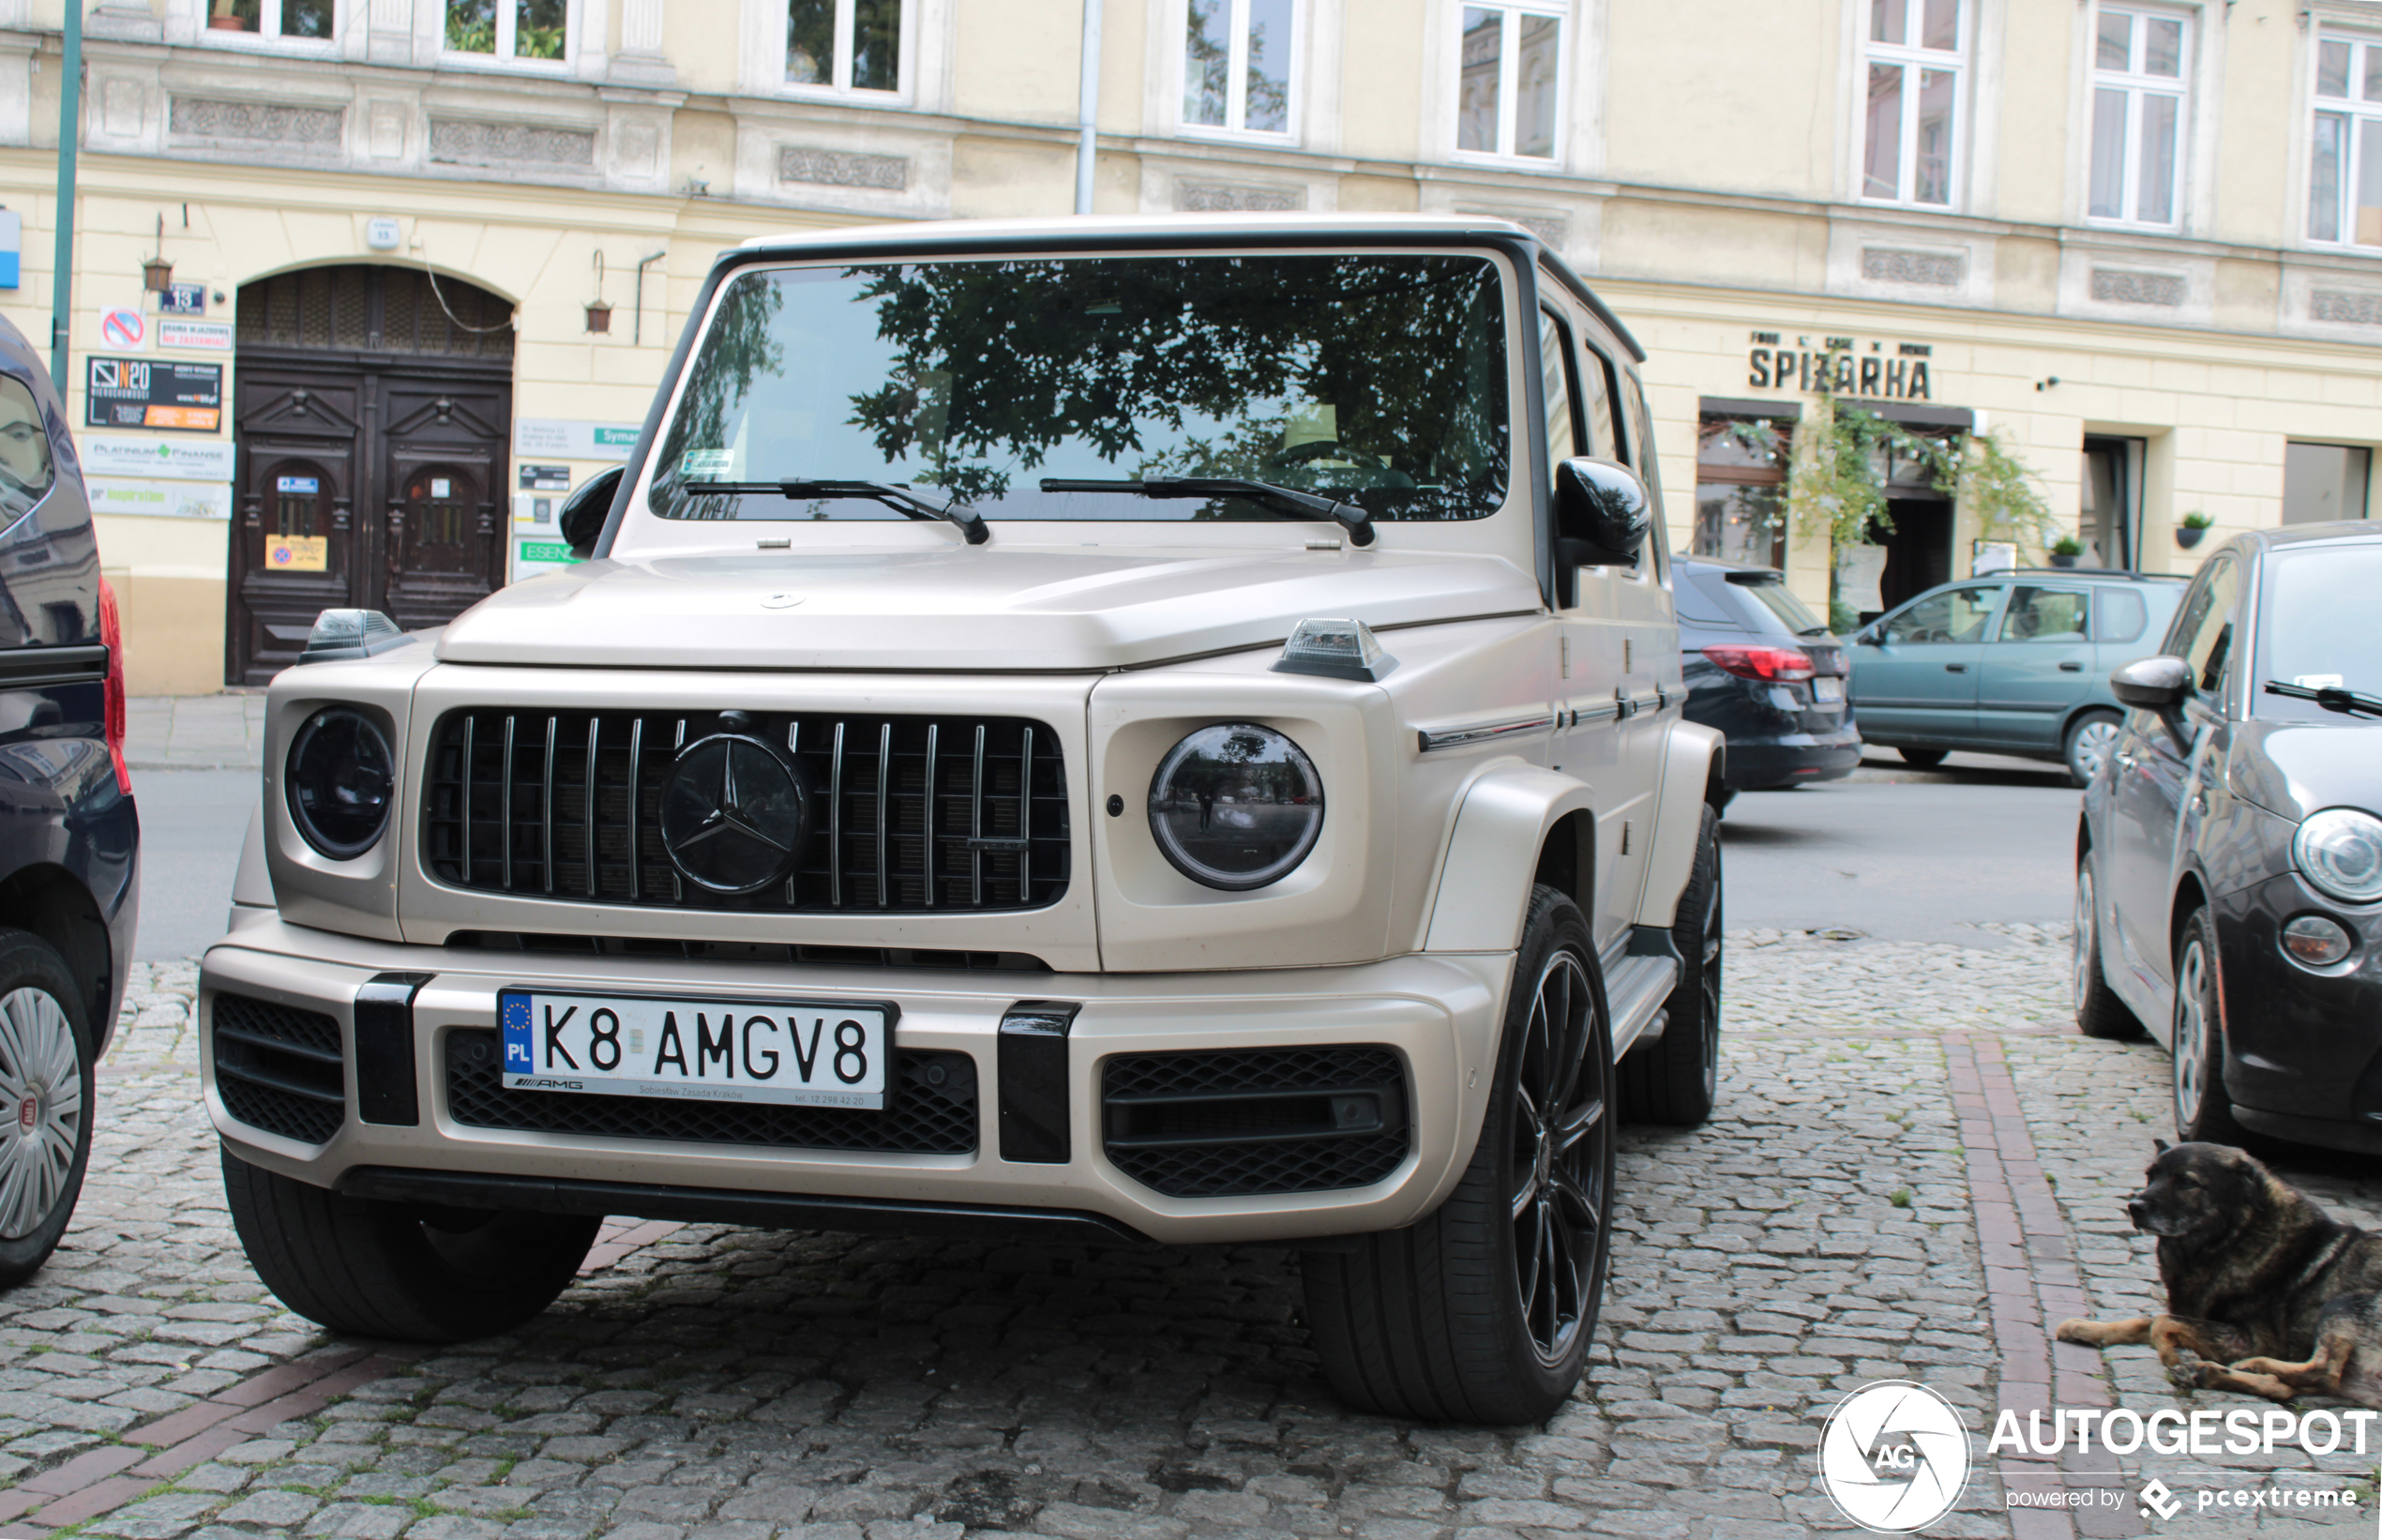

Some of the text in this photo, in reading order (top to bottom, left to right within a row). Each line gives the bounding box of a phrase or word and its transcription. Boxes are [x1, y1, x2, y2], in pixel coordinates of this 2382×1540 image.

[173, 290, 193, 308] 13
[91, 488, 104, 502] pr
[507, 1043, 531, 1062] PL
[544, 1004, 867, 1085] K8 AMGV8
[682, 1087, 711, 1097] Zasada
[713, 1089, 744, 1099] Kraków
[795, 1094, 808, 1103] tel.
[822, 1095, 838, 1105] 298
[839, 1096, 852, 1105] 42
[852, 1096, 864, 1106] 20
[24, 1100, 35, 1124] FIAT
